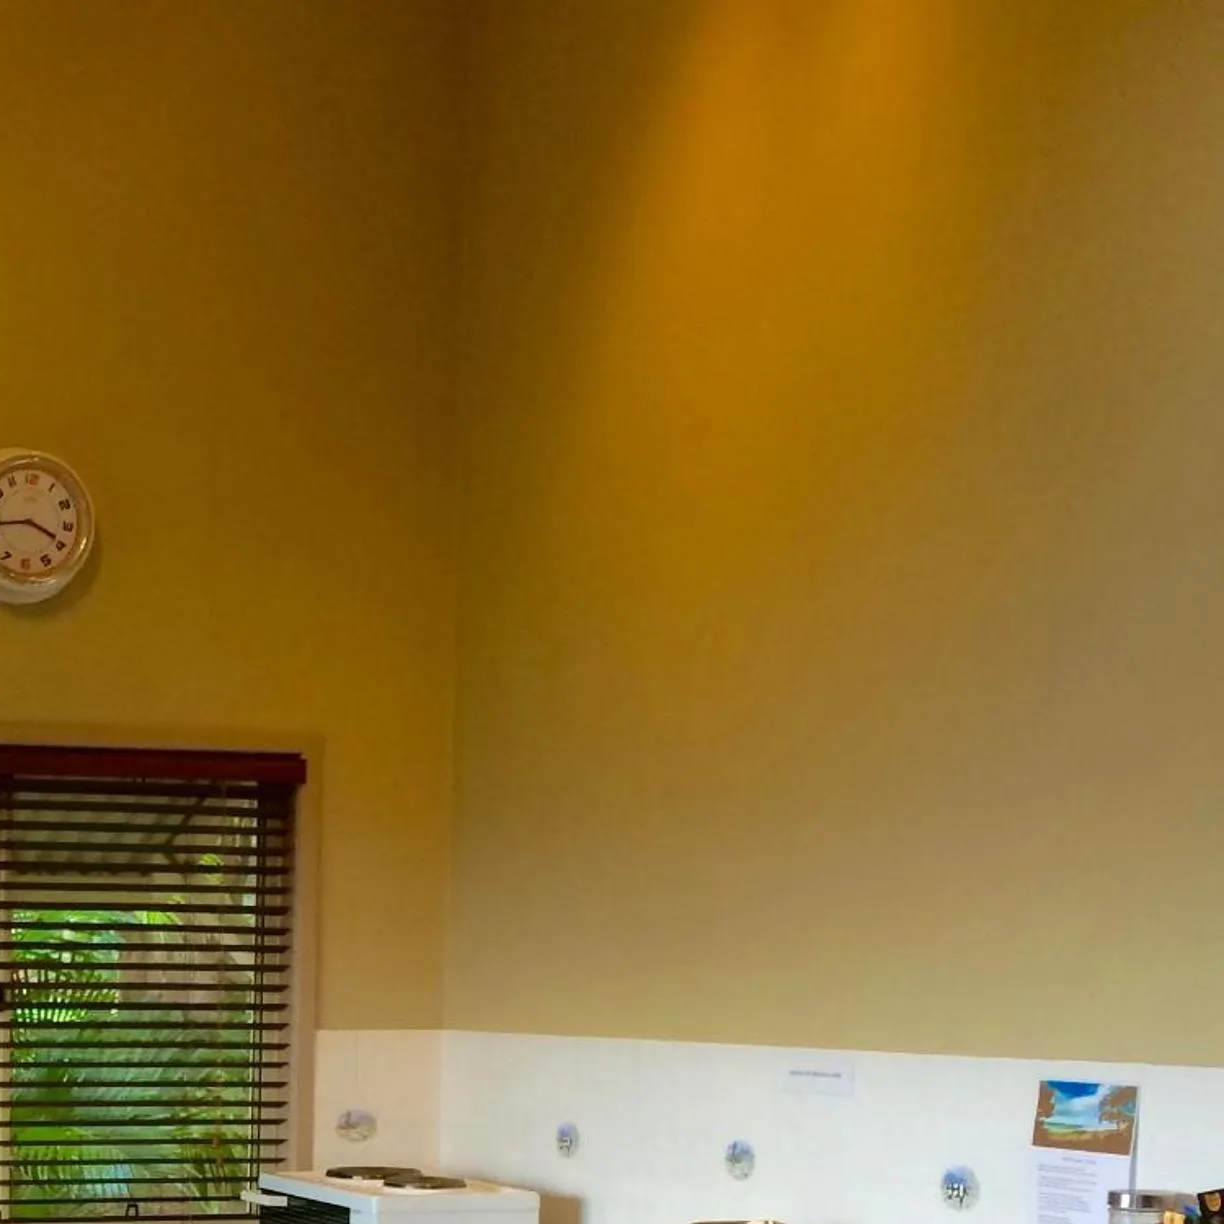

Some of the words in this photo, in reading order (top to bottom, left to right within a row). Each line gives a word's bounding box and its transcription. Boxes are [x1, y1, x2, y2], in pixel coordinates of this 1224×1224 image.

[7, 475, 17, 488] 11
[26, 473, 39, 486] 12
[48, 483, 55, 492] 1
[58, 499, 71, 511] 2
[63, 521, 74, 533] 3
[56, 540, 66, 552] 4
[0, 551, 12, 561] 7
[40, 554, 52, 567] 5
[20, 558, 30, 570] 6
